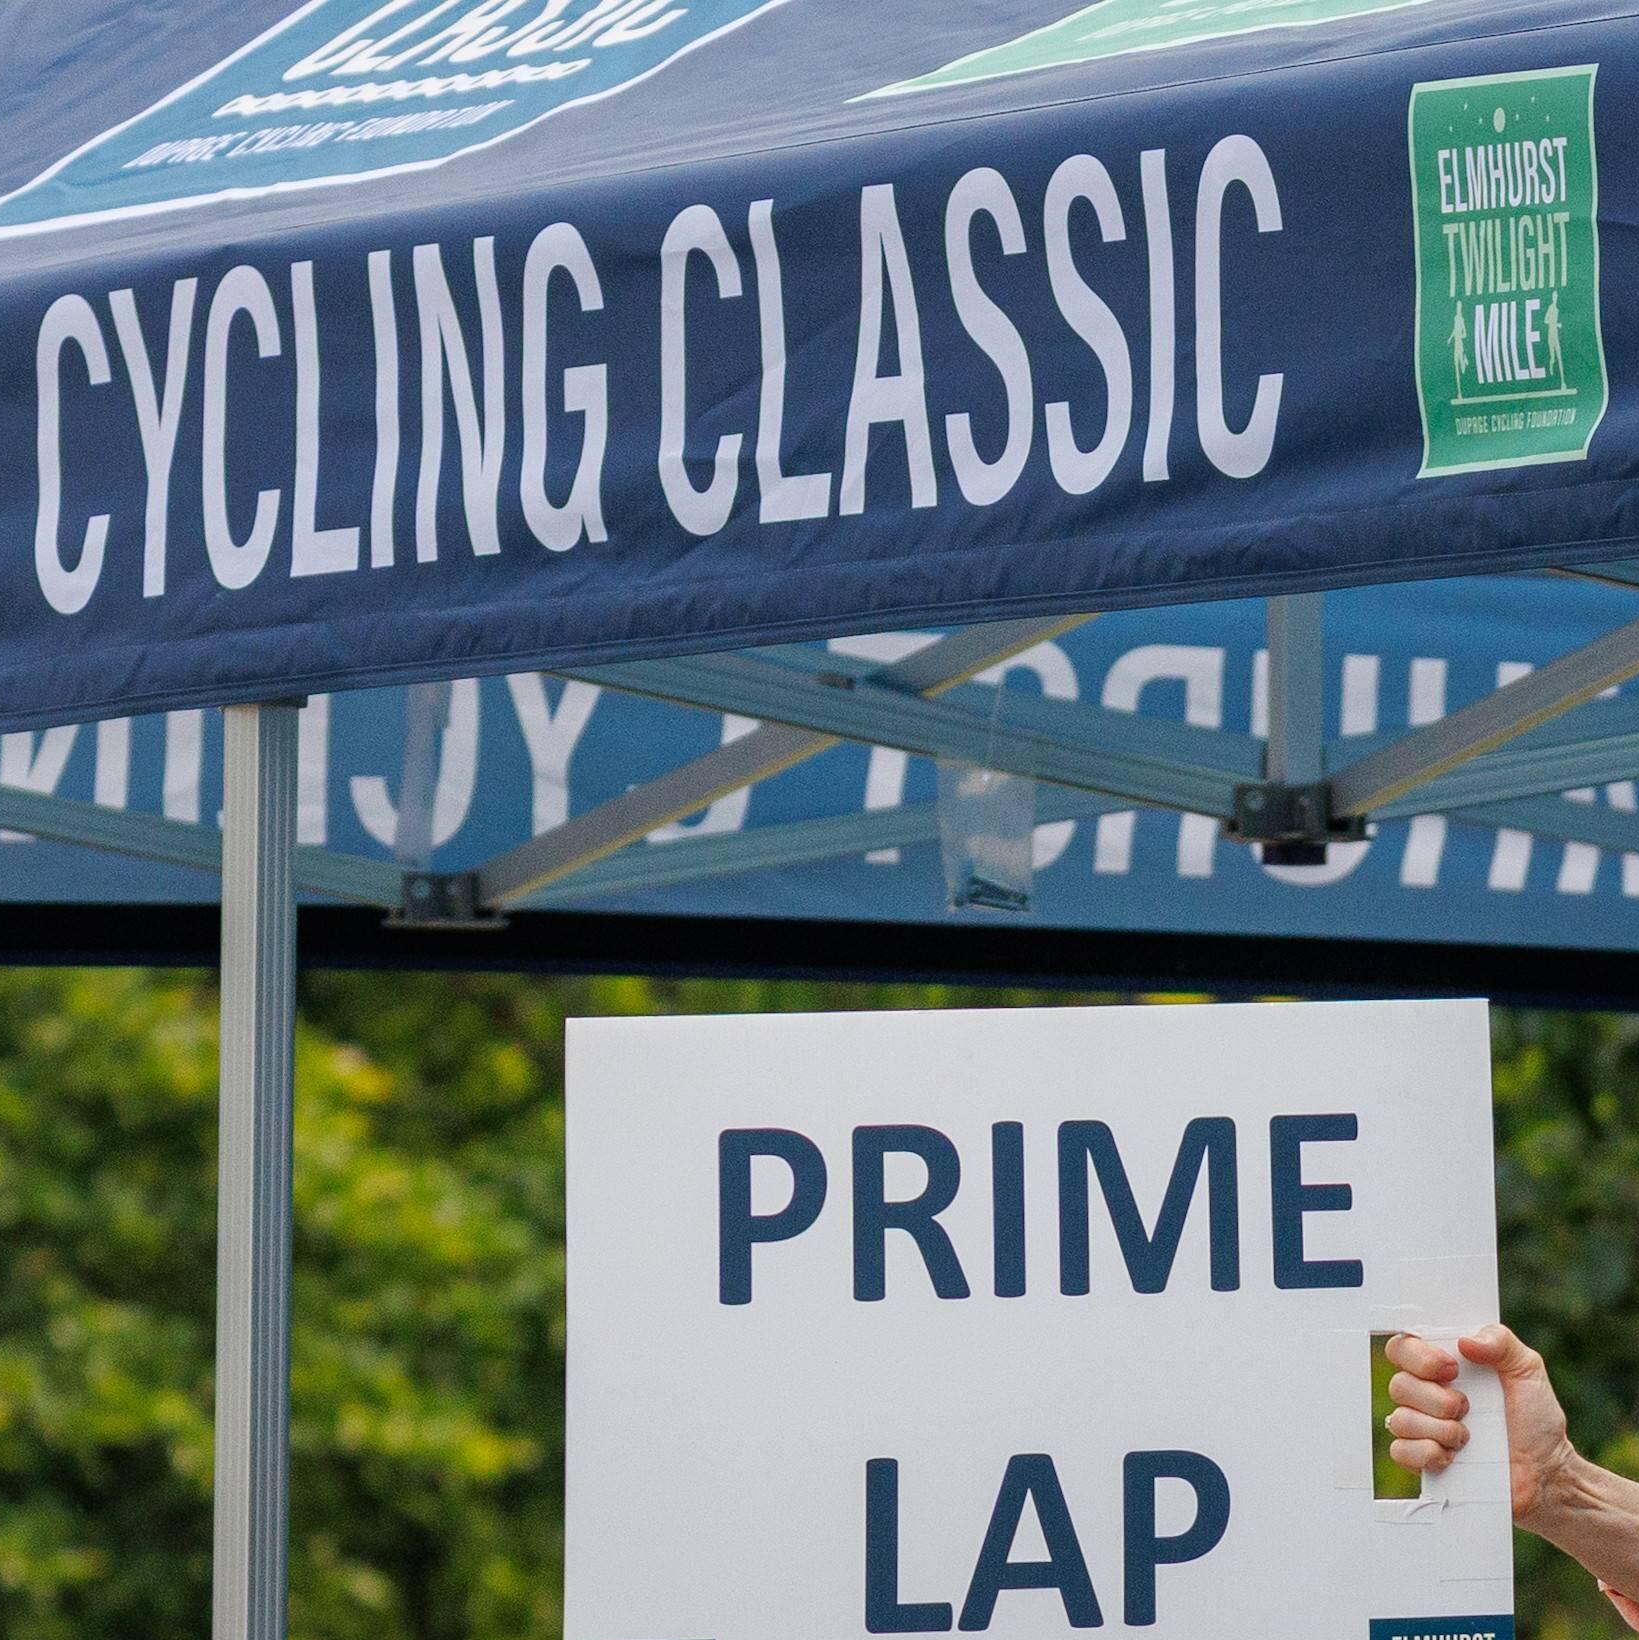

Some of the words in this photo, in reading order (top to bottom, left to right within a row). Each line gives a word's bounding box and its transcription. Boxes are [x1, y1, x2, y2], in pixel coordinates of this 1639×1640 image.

[1437, 137, 1568, 214] ELMHURST
[1442, 212, 1571, 298] TWILIGHT
[34, 221, 610, 616] CYCLING
[659, 133, 1285, 537] CLASSIC
[1474, 299, 1547, 384] MILE
[718, 1113, 1364, 1305] PRIME
[865, 1450, 1231, 1634] LAP
